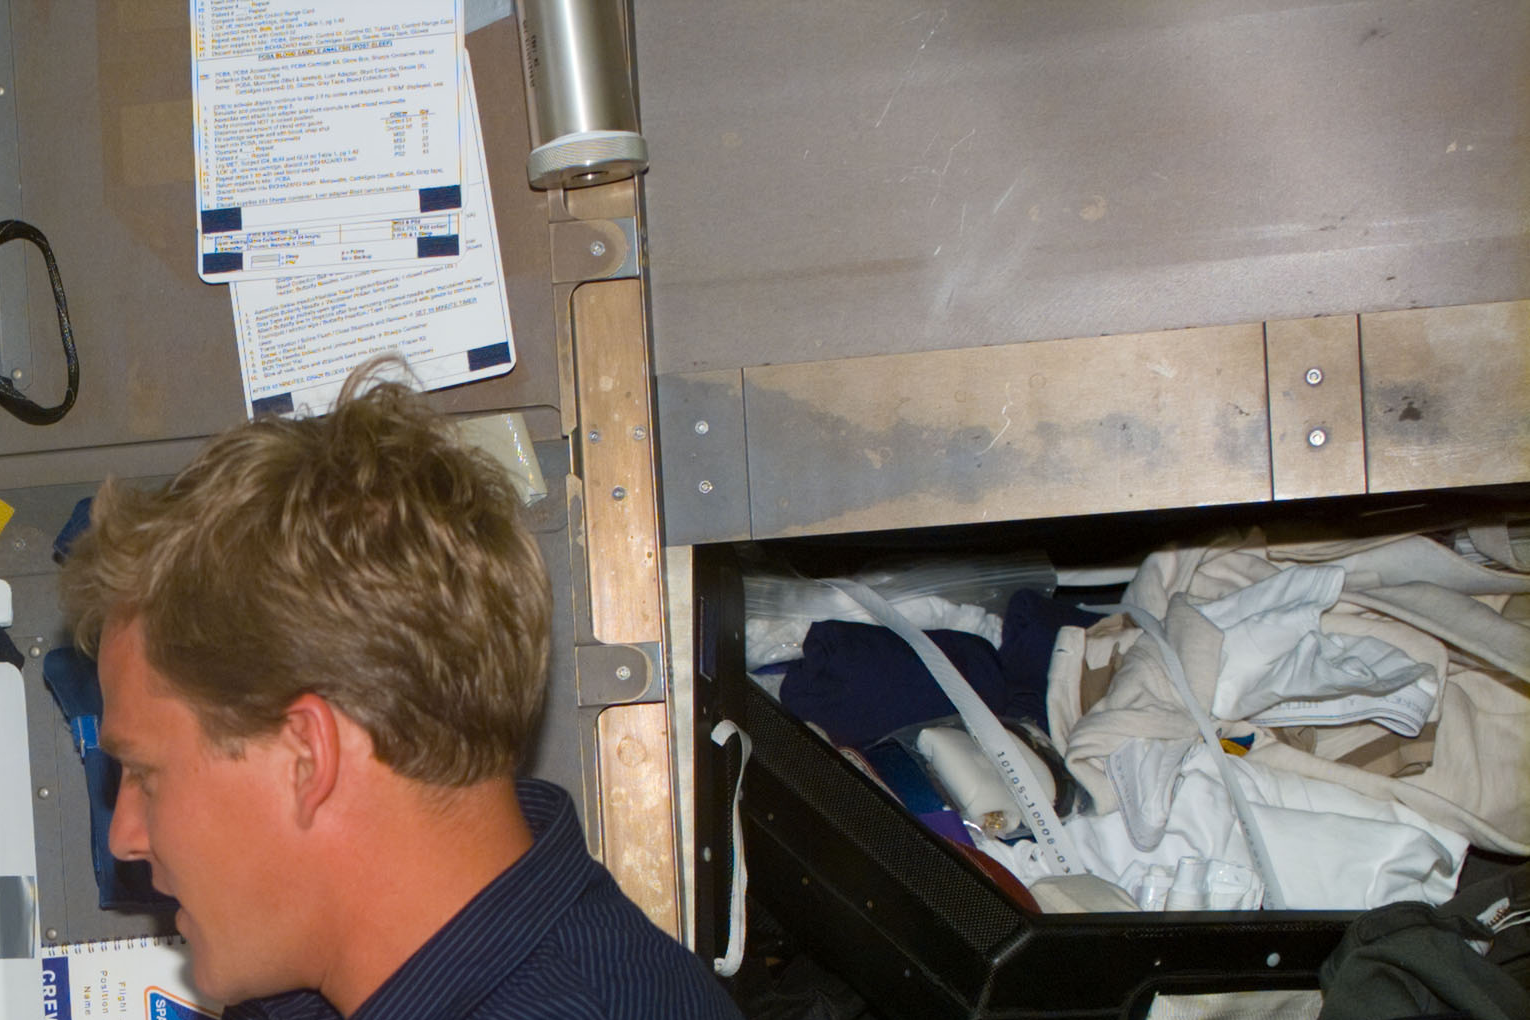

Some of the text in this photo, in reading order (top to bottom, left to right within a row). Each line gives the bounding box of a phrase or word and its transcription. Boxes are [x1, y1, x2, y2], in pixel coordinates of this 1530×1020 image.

[83, 985, 93, 1017] Name
[100, 969, 110, 1015] Position
[118, 981, 128, 1014] Flight
